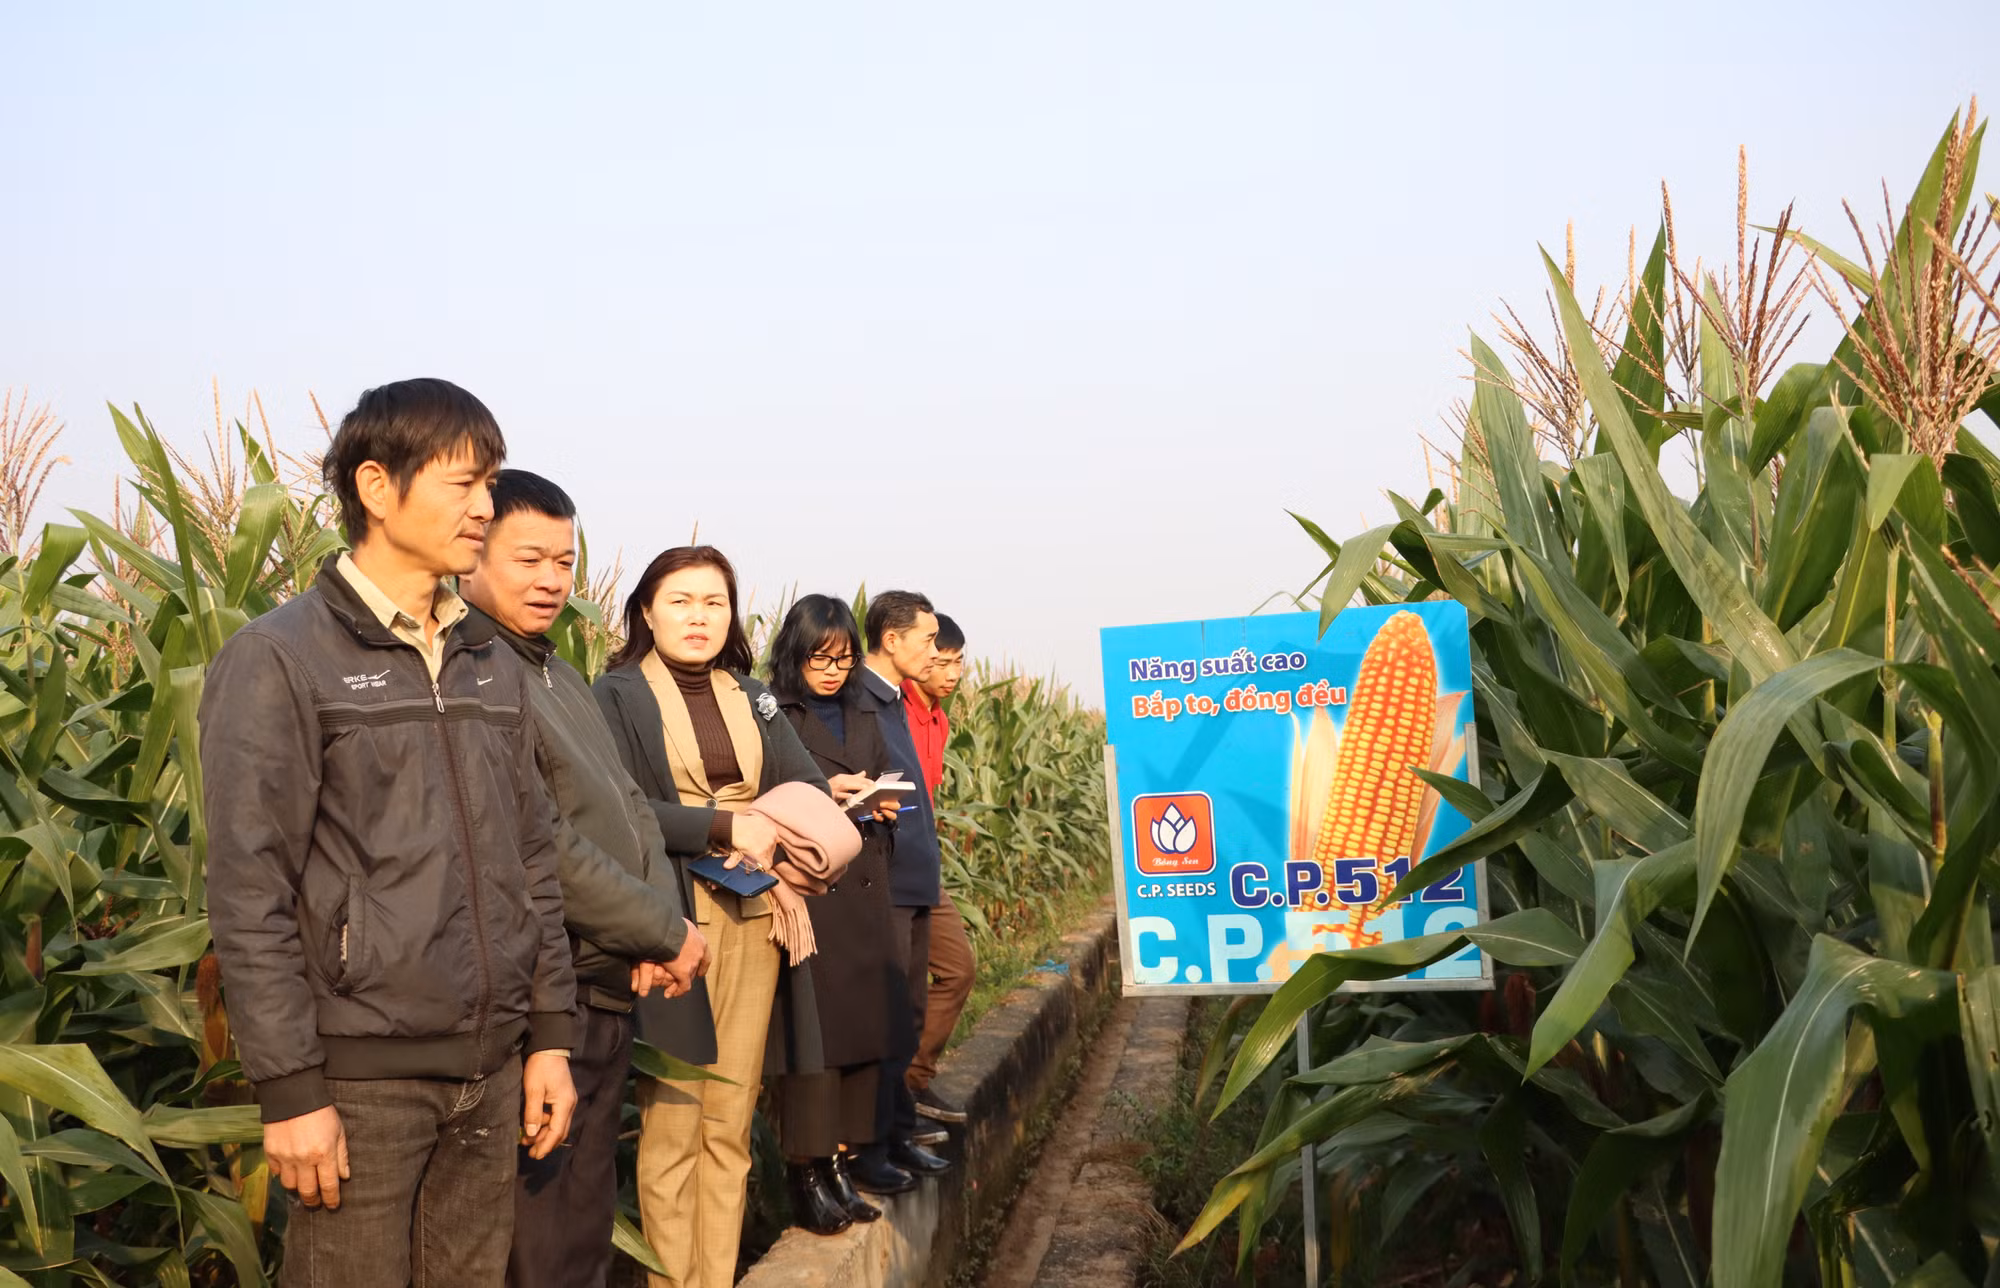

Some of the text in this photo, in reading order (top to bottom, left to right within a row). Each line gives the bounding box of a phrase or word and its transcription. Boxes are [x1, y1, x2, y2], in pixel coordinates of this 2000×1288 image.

[1130, 648, 1306, 682] Năng suất cao
[1132, 680, 1346, 721] Bắp to, đồng đều
[1181, 856, 1199, 865] Sen
[1137, 882, 1217, 898] C.P. SEEDS
